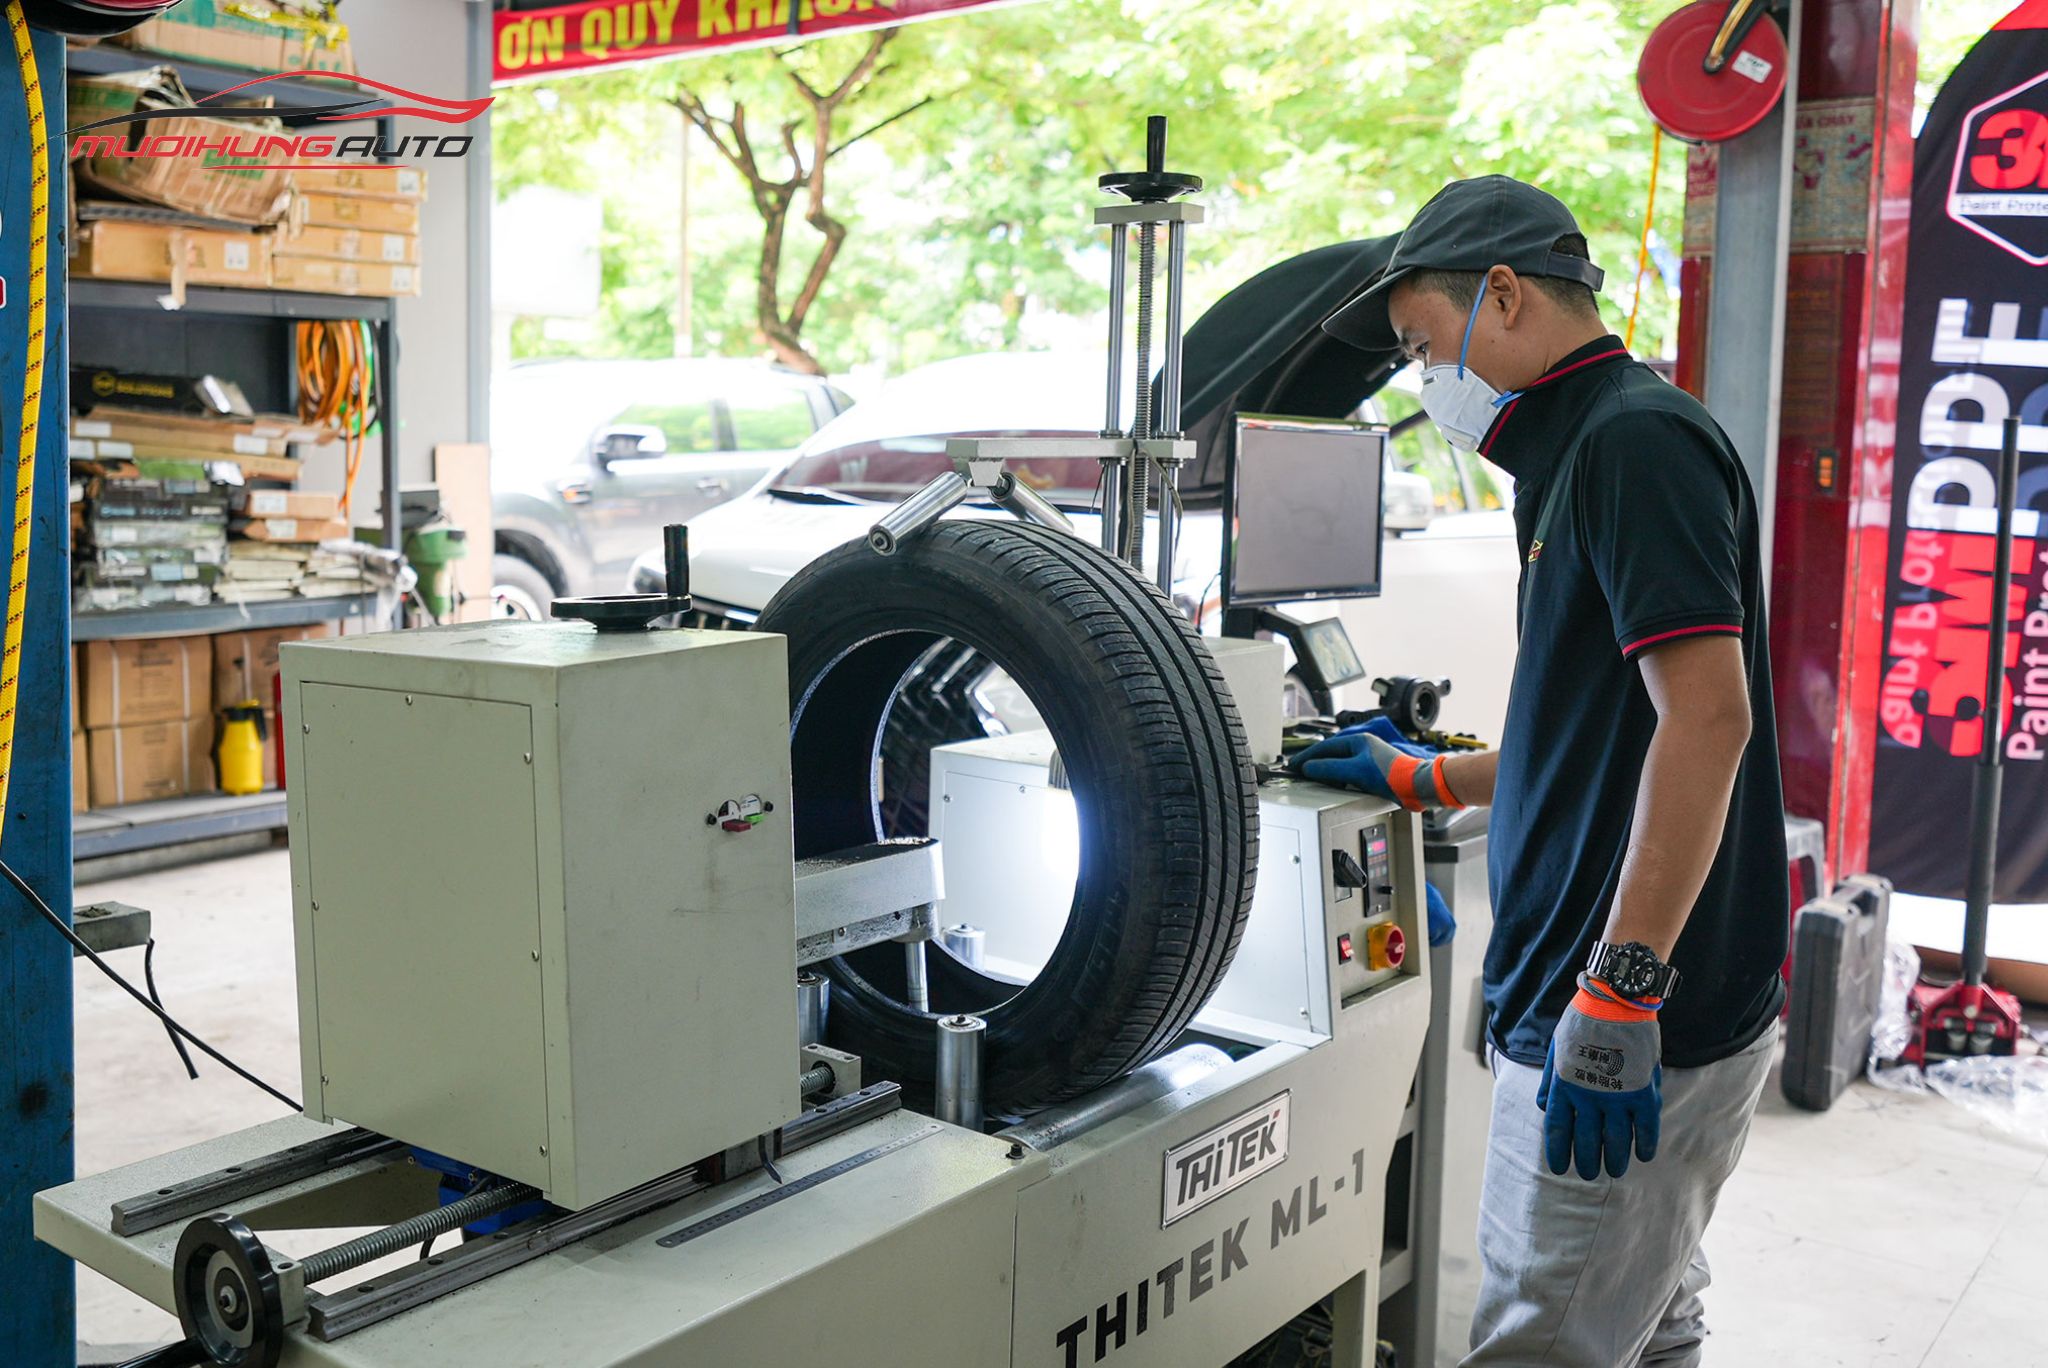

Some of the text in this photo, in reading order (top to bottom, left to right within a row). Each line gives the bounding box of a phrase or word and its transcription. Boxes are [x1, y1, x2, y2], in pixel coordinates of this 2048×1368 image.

[499, 16, 566, 70] ƠN
[1056, 1148, 1364, 1368] THITEK ML-1
